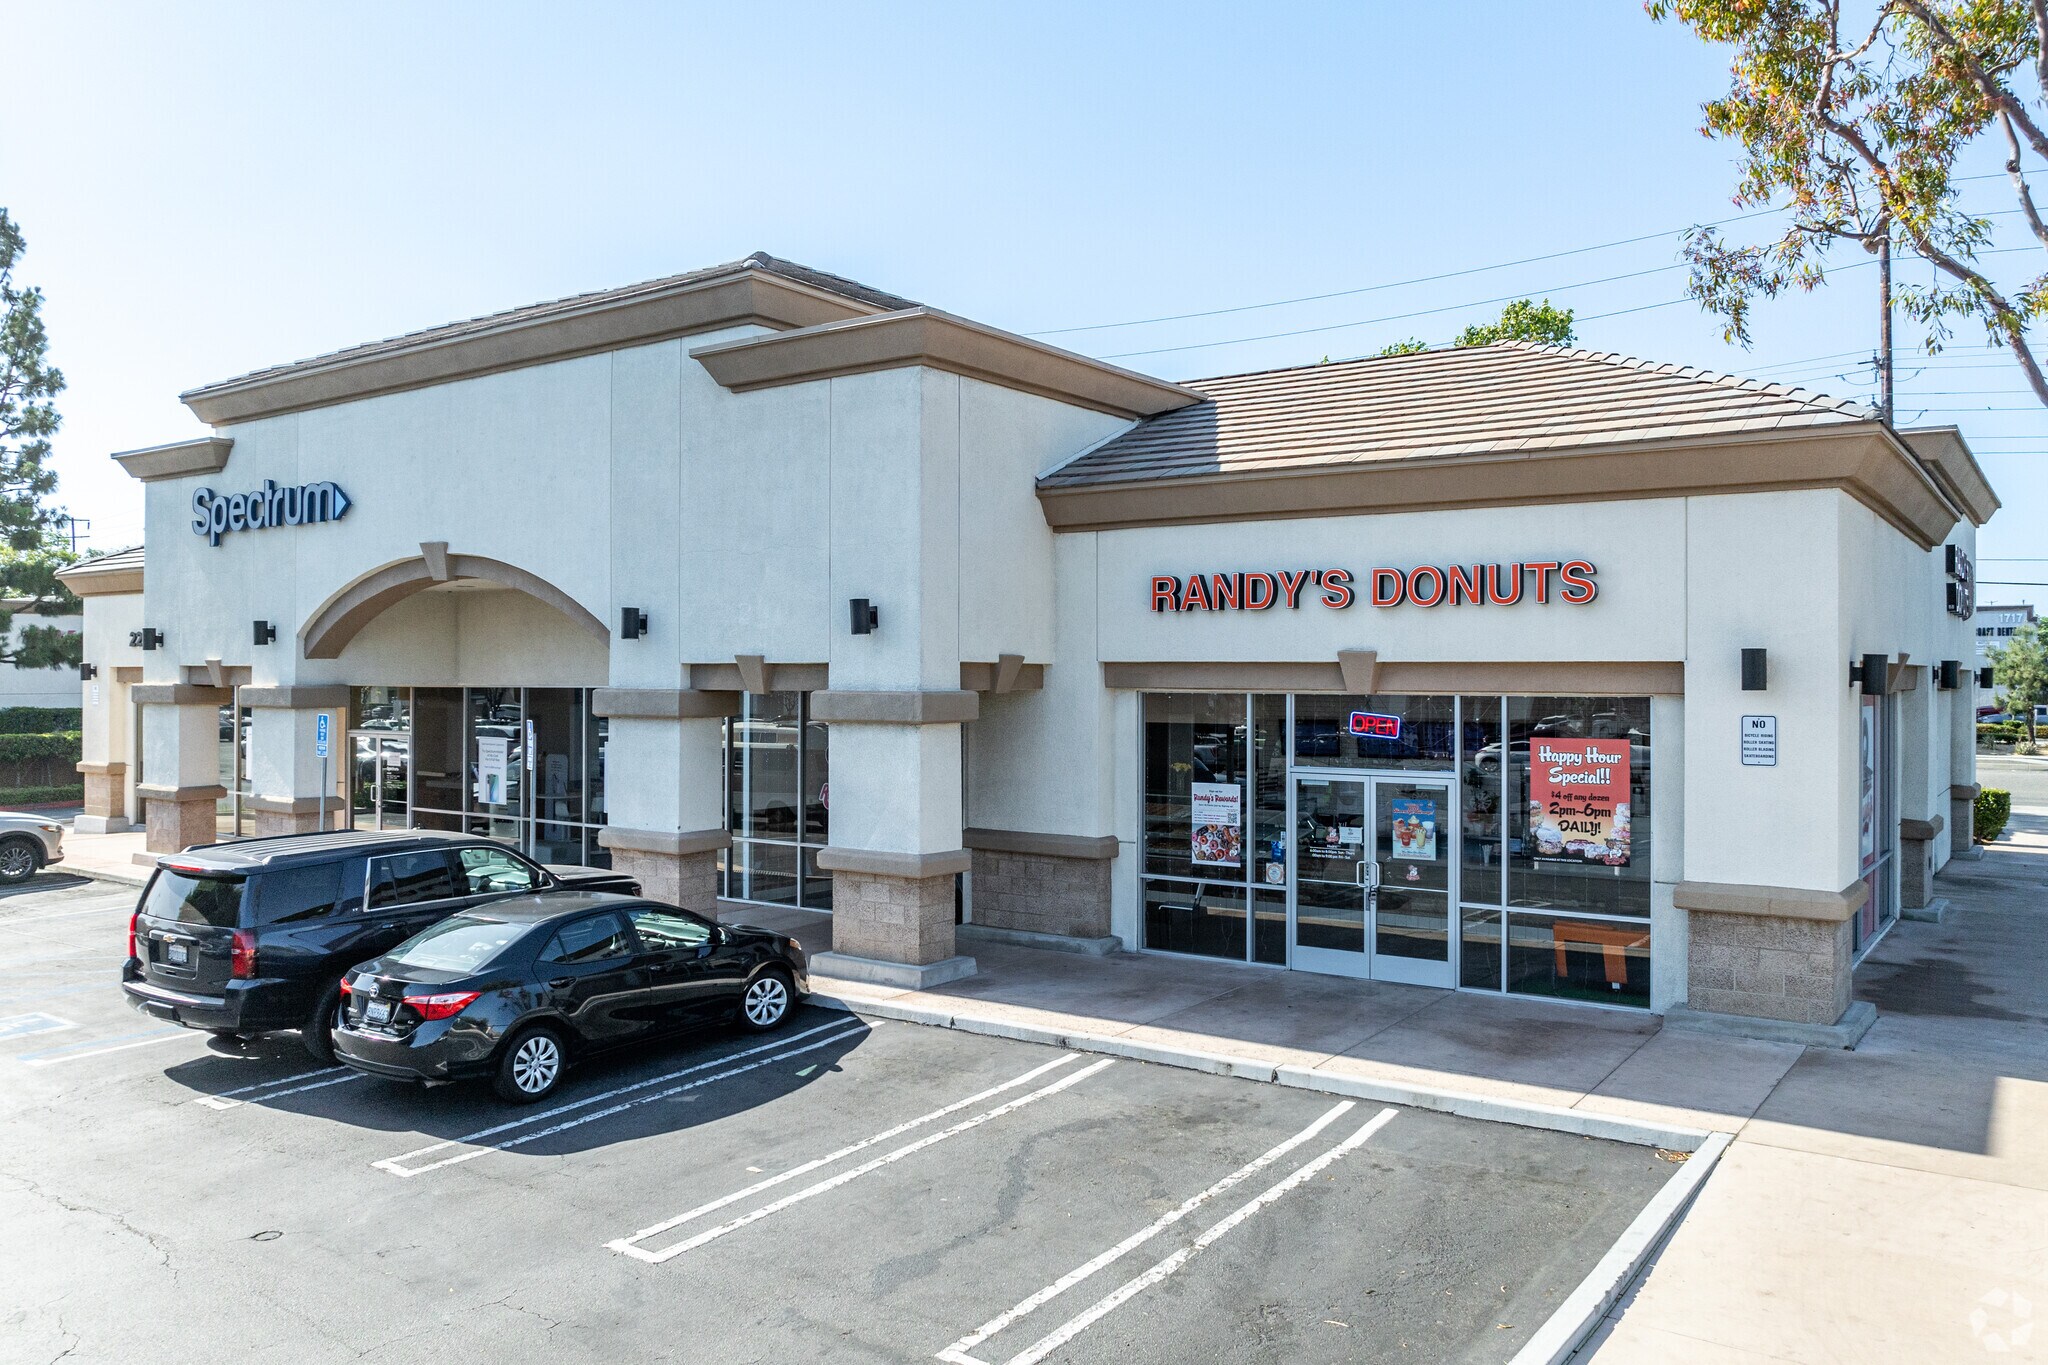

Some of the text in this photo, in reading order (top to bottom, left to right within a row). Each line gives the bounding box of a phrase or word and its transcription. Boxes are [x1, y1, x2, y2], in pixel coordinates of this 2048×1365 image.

[191, 479, 336, 547] Spectrum
[1150, 559, 1600, 613] RANDY'S DONUTS
[1999, 613, 2023, 623] 1717
[1352, 714, 1399, 736] OPEN
[1752, 720, 1766, 729] NO
[1538, 745, 1622, 767] Happy Hour
[1548, 766, 1611, 787] Special!!
[1193, 793, 1239, 803] Randy's Rewards!
[1551, 791, 1610, 803] $4 off any dozen
[1558, 820, 1602, 836] DAILY!
